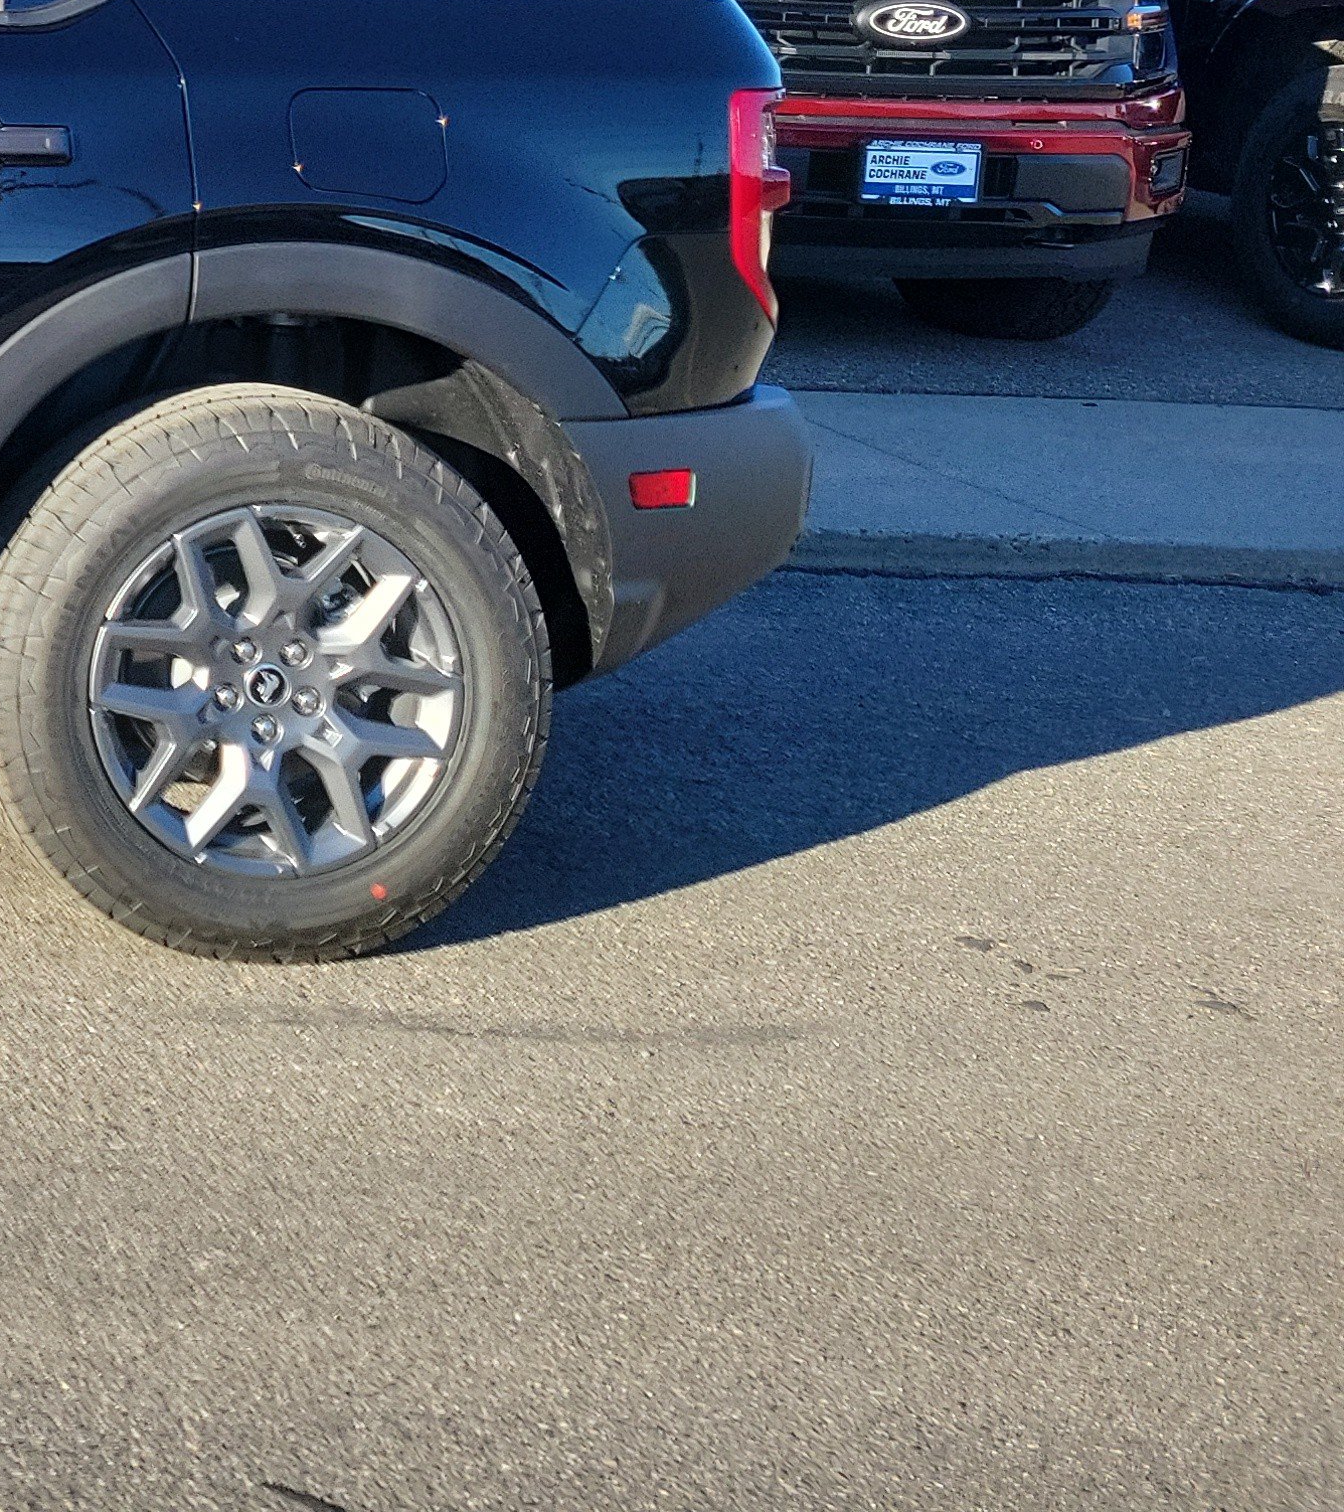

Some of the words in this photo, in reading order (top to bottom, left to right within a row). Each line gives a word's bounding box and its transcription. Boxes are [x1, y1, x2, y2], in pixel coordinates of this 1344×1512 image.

[887, 8, 949, 34] Ford
[870, 155, 910, 165] ARCHIE
[869, 168, 927, 180] COCHRANE
[935, 198, 952, 207] MT
